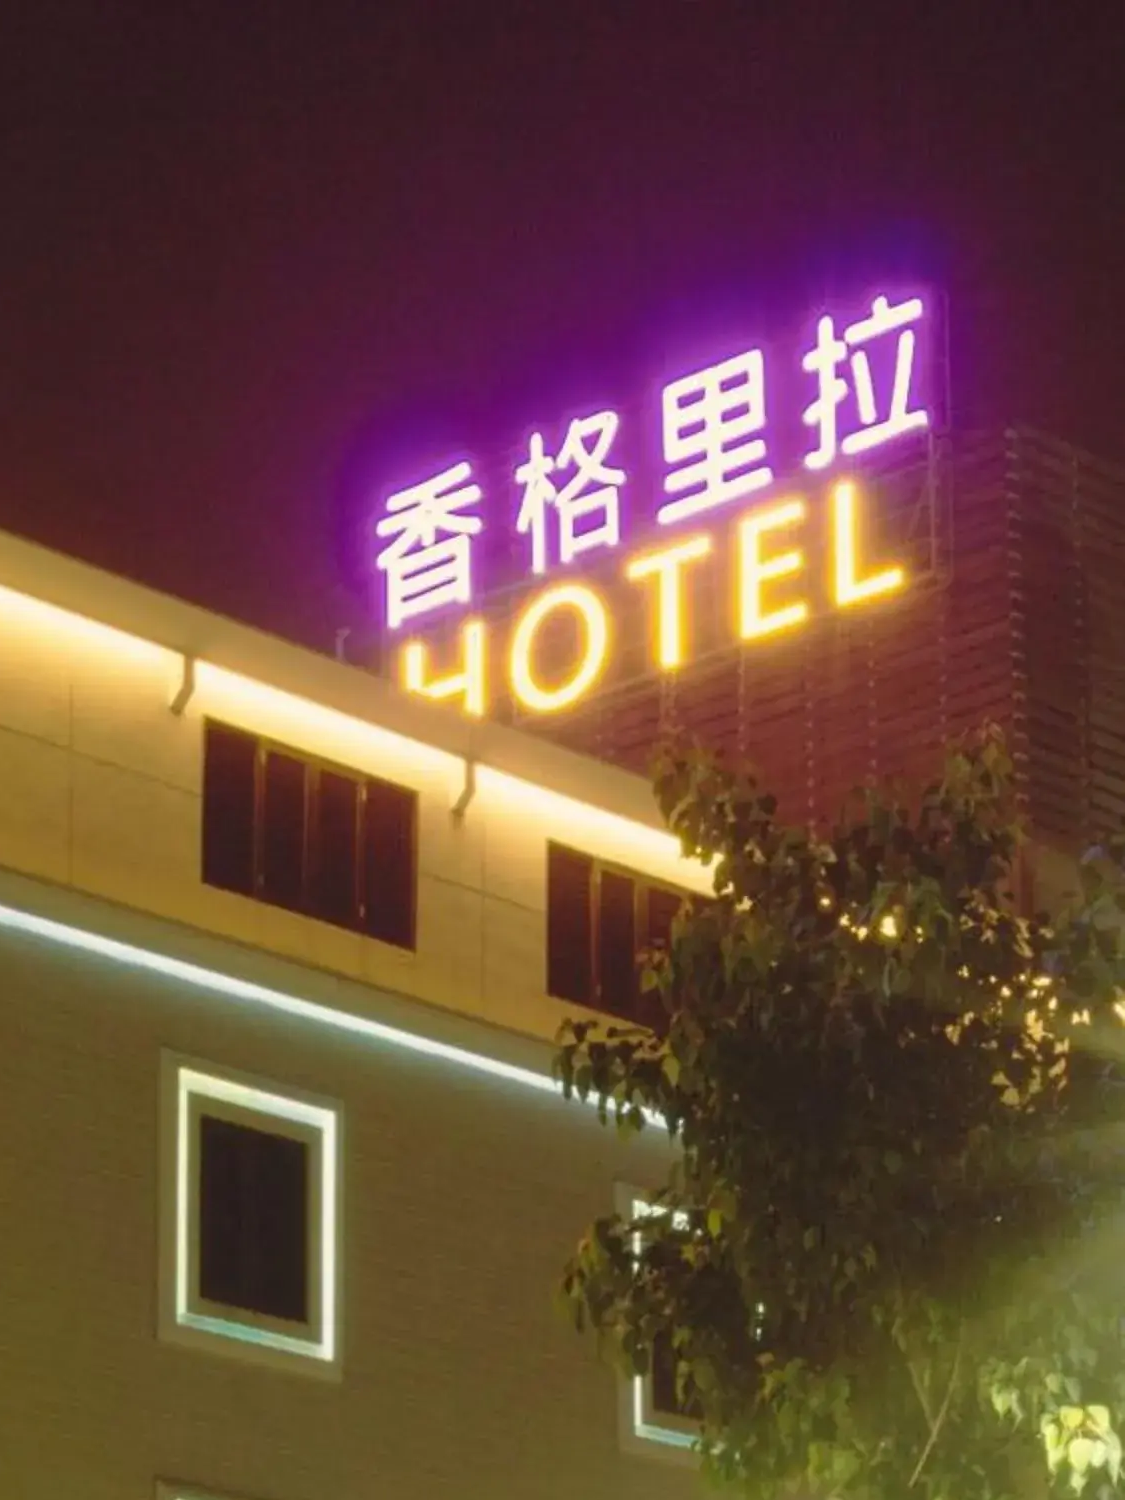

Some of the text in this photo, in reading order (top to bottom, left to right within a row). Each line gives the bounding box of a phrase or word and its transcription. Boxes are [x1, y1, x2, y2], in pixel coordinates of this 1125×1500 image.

[375, 294, 930, 630] 香格里拉
[404, 478, 905, 718] HOTEL
